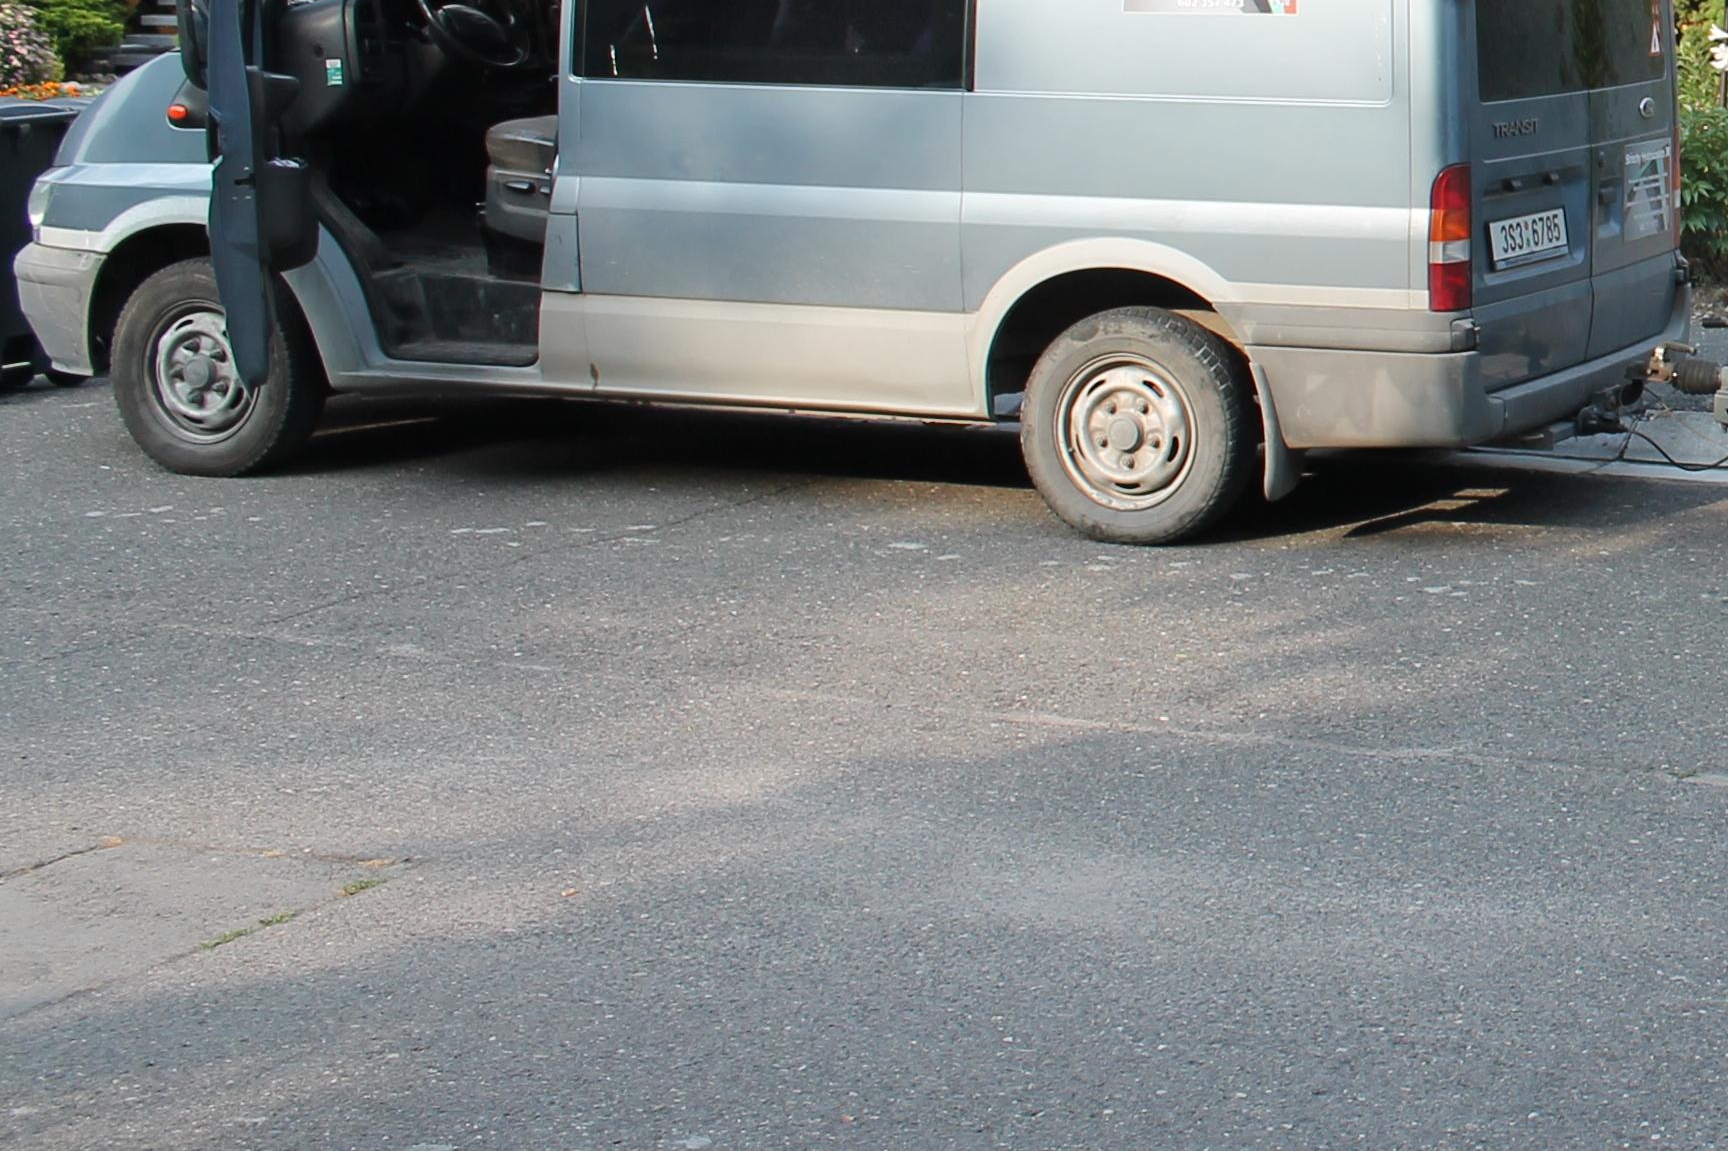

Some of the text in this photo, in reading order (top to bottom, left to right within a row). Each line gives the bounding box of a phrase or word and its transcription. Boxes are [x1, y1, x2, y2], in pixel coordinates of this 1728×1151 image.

[1493, 118, 1539, 138] TRANSIT
[1500, 214, 1561, 253] 3S3 6785
